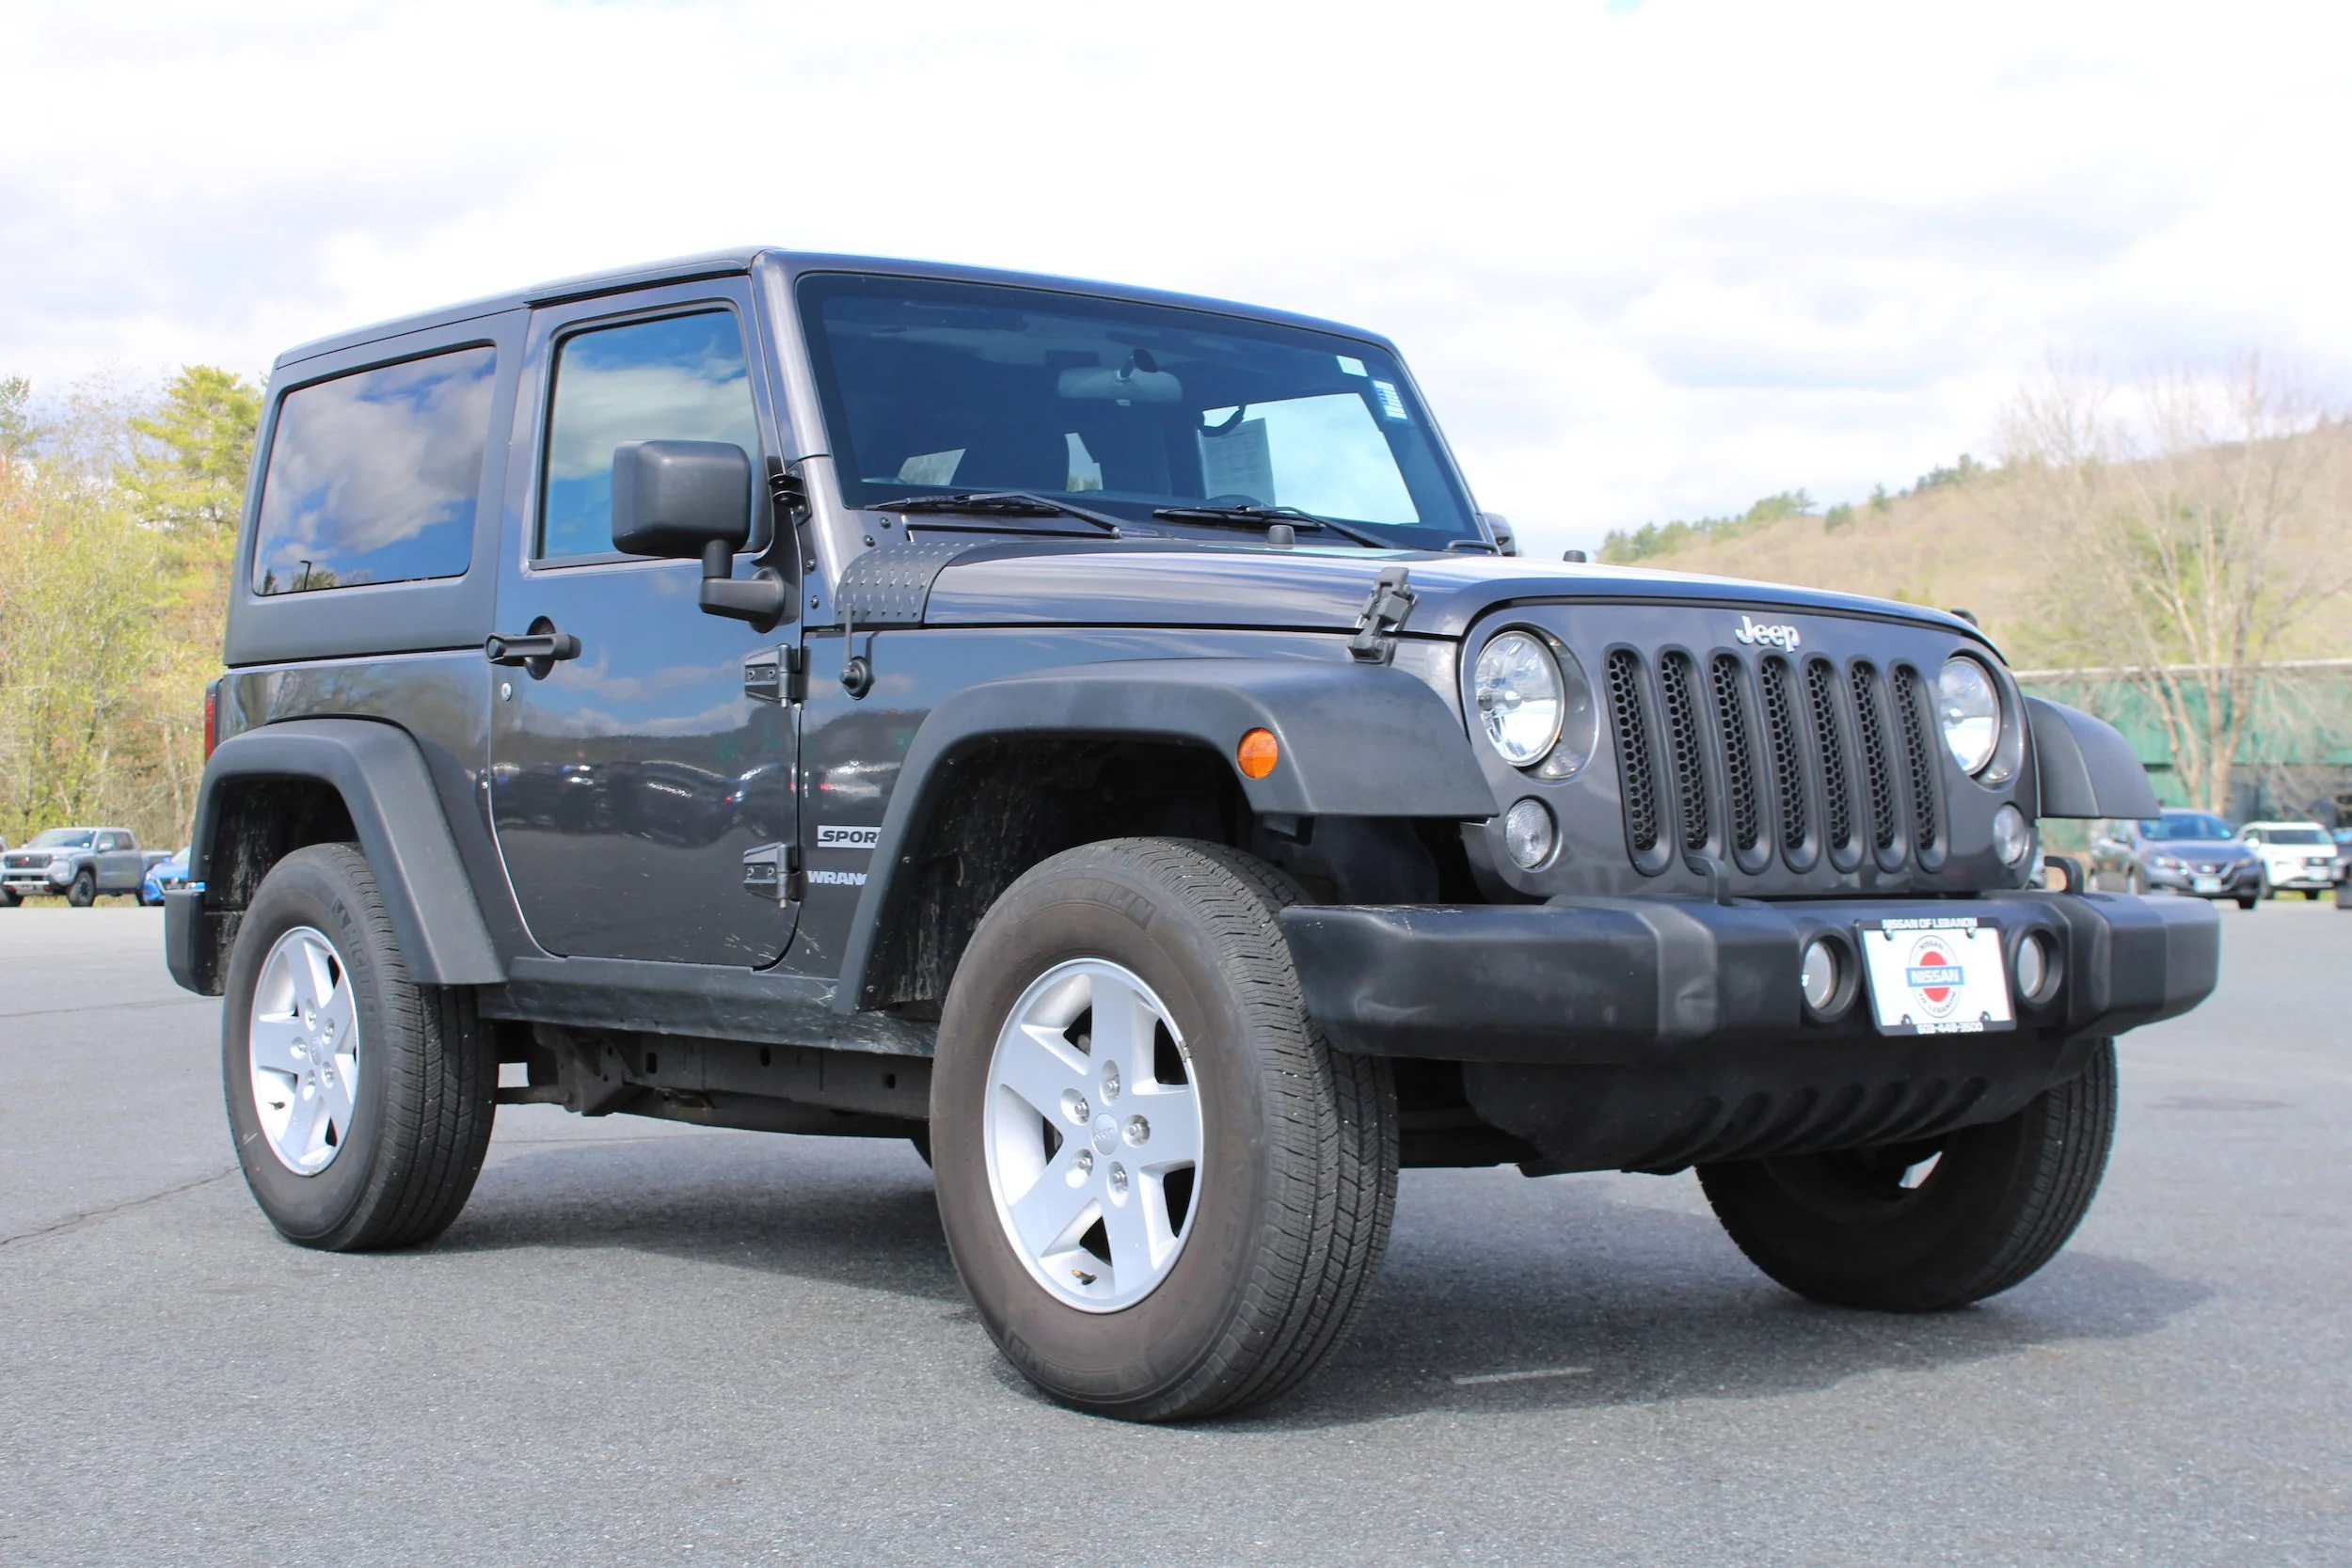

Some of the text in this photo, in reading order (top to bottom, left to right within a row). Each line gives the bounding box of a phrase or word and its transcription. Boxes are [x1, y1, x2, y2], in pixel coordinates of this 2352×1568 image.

[1735, 615, 1801, 652] Jeep
[819, 831, 881, 844] SPOR
[1883, 917, 1978, 929] NISSAN OF LEBANON
[1919, 941, 1944, 950] NISSAN
[1911, 969, 1959, 984] NISSAN
